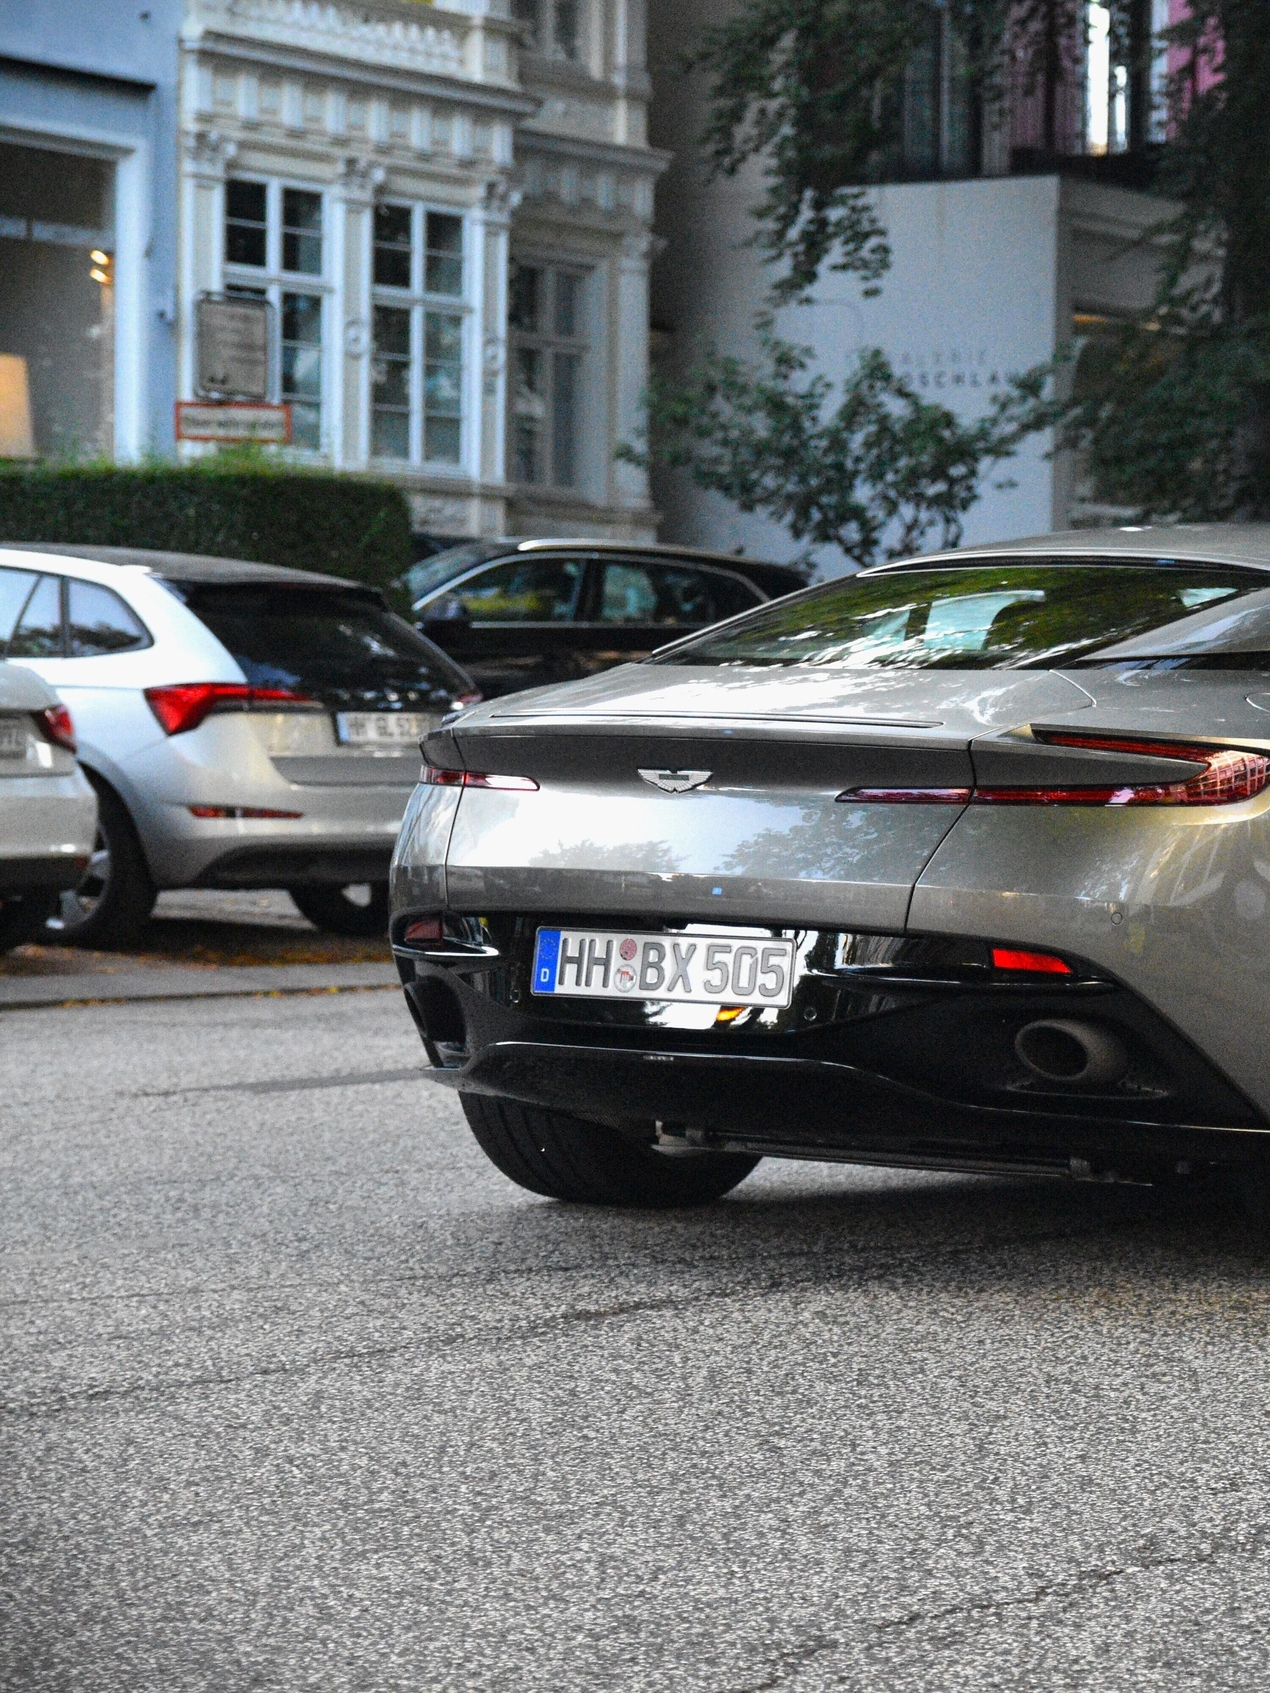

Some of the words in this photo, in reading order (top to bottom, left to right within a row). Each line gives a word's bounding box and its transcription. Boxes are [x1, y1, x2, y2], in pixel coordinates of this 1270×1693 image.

[540, 968, 549, 982] D
[558, 937, 615, 988] HH
[638, 942, 697, 993] BX
[703, 944, 788, 998] 505
